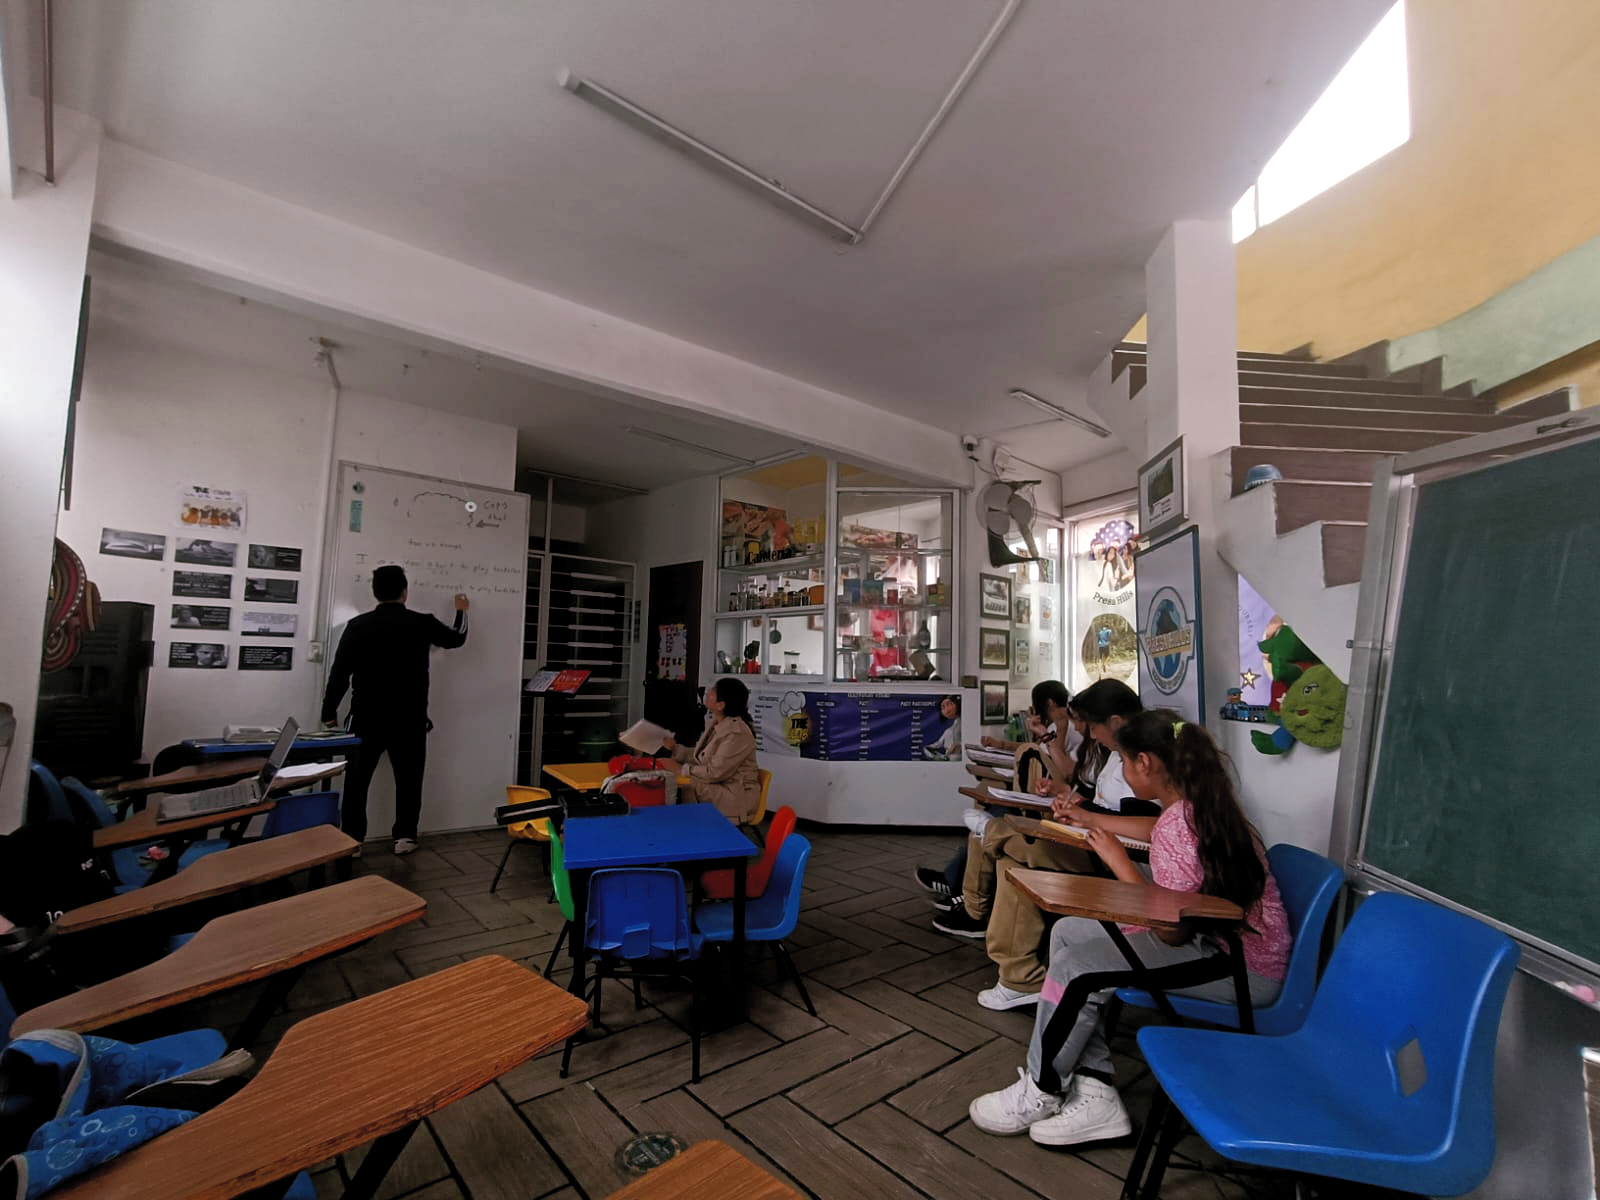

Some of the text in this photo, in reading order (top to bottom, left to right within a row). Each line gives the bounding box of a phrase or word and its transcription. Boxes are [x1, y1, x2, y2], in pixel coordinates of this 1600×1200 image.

[1092, 590, 1133, 605] Presa Hills
[791, 718, 808, 729] THE
